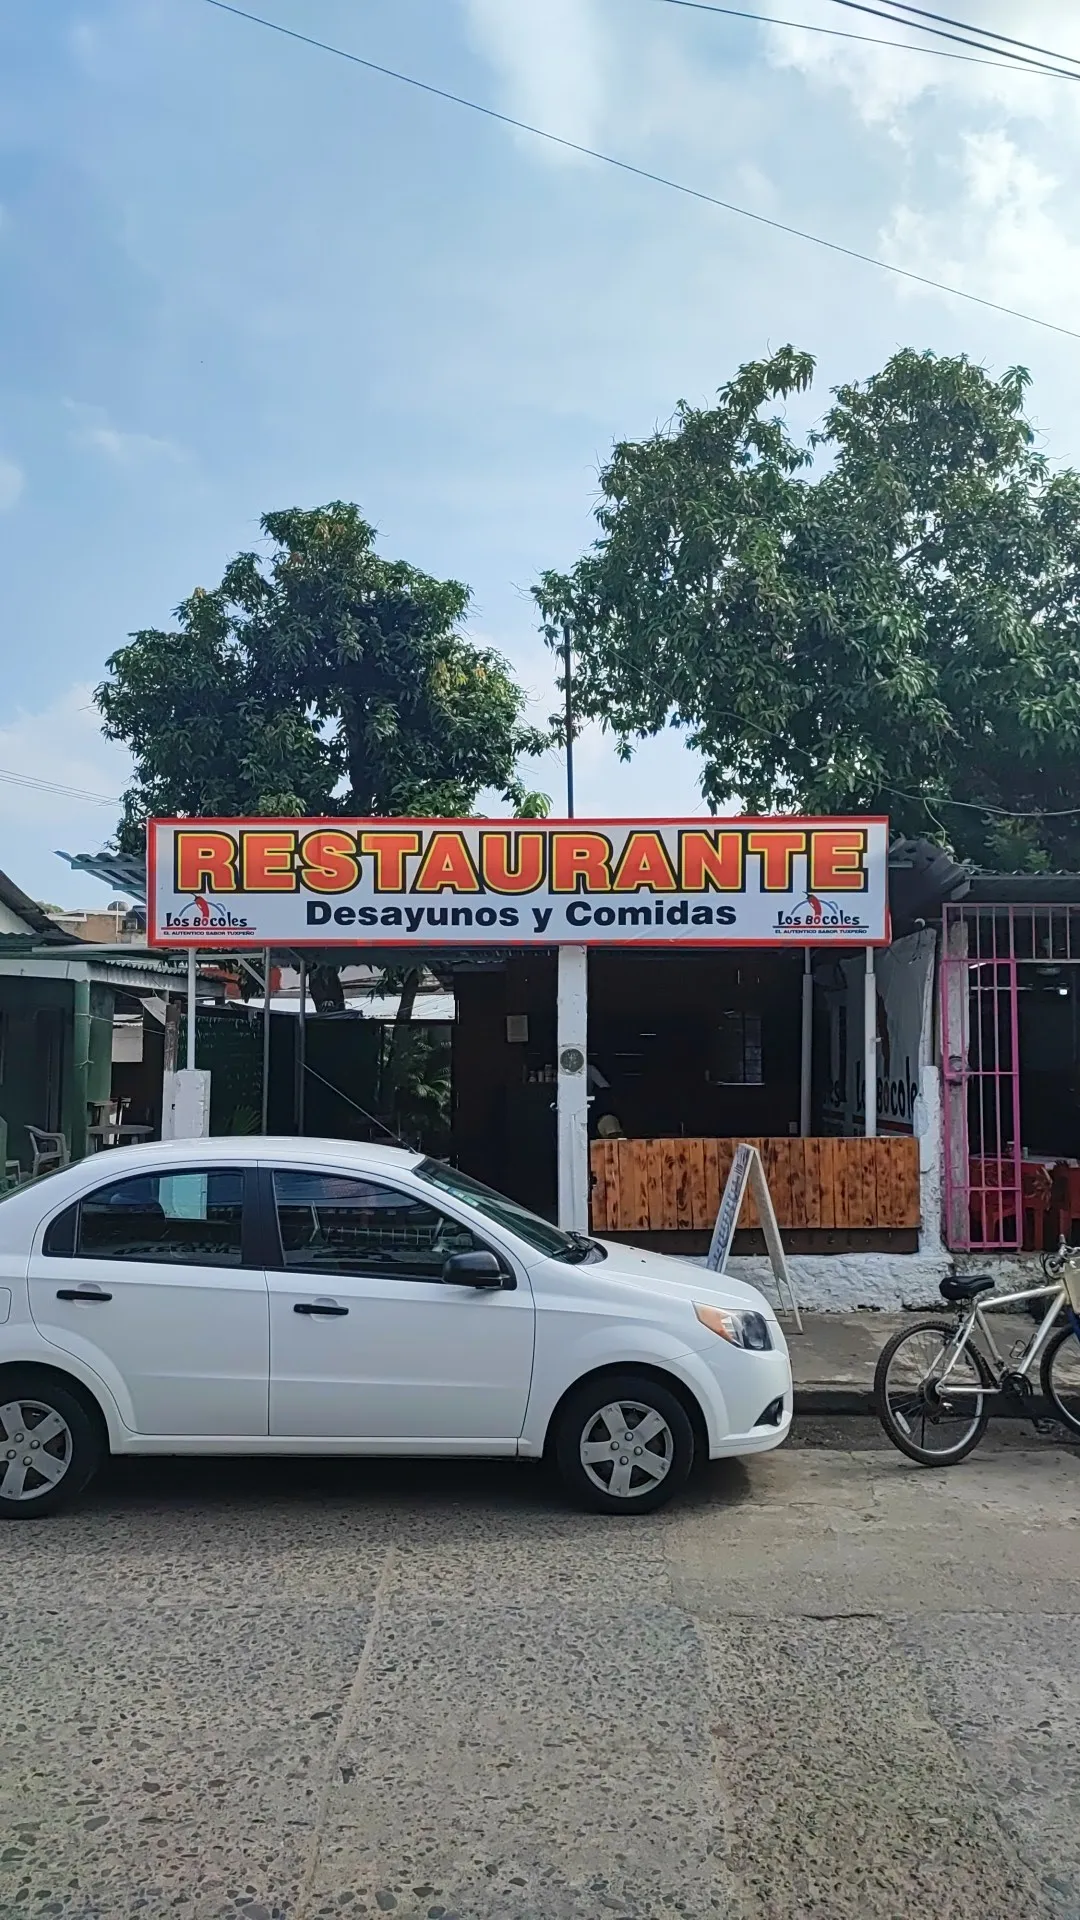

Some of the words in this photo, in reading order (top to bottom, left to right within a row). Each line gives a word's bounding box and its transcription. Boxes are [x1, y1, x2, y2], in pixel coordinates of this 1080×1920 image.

[174, 828, 868, 895] RESTAURANTE
[166, 912, 190, 927] Los
[194, 912, 247, 927] Bocoles
[306, 900, 520, 932] Desayunos
[532, 906, 553, 933] y
[565, 900, 737, 926] Comidas
[777, 910, 802, 925] Los
[806, 910, 860, 925] Bocoles
[876, 1055, 918, 1120] Bocole
